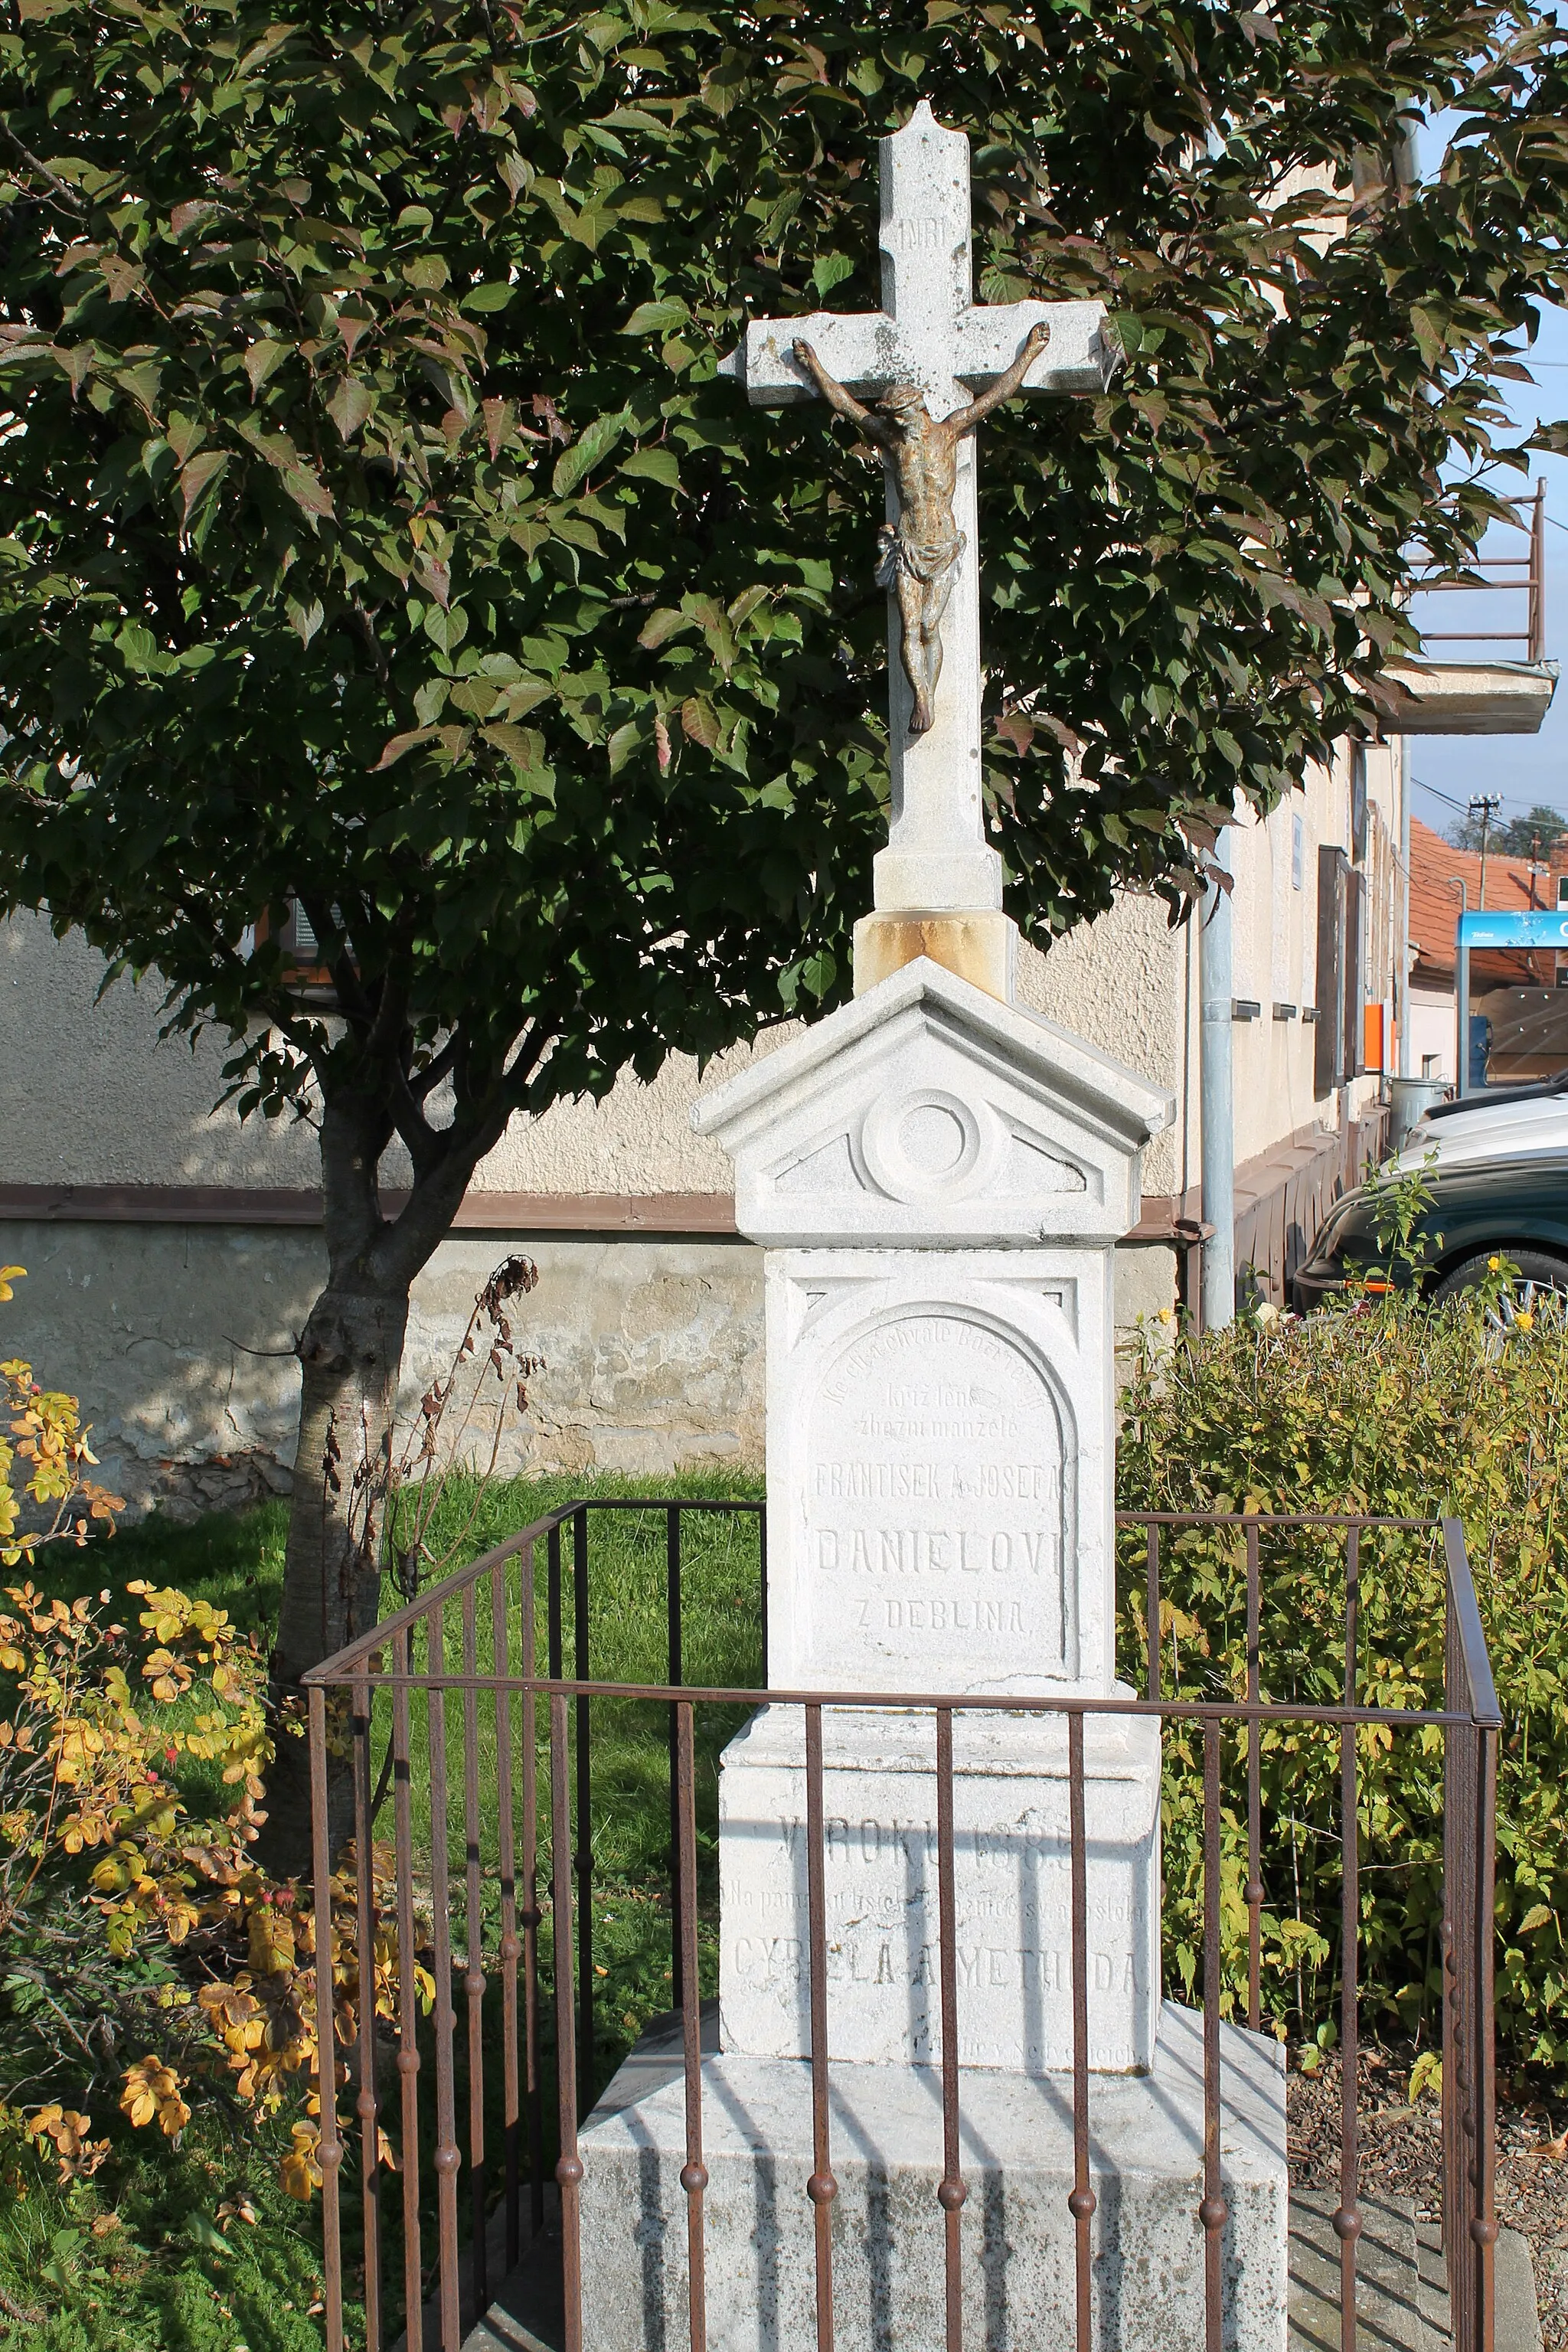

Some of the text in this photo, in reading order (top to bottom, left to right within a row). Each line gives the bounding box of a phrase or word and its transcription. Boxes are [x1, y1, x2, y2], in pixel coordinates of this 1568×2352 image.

[898, 217, 949, 250] INRI
[815, 1529, 1060, 1575] DANIELOVI
[854, 1599, 870, 1627] Z
